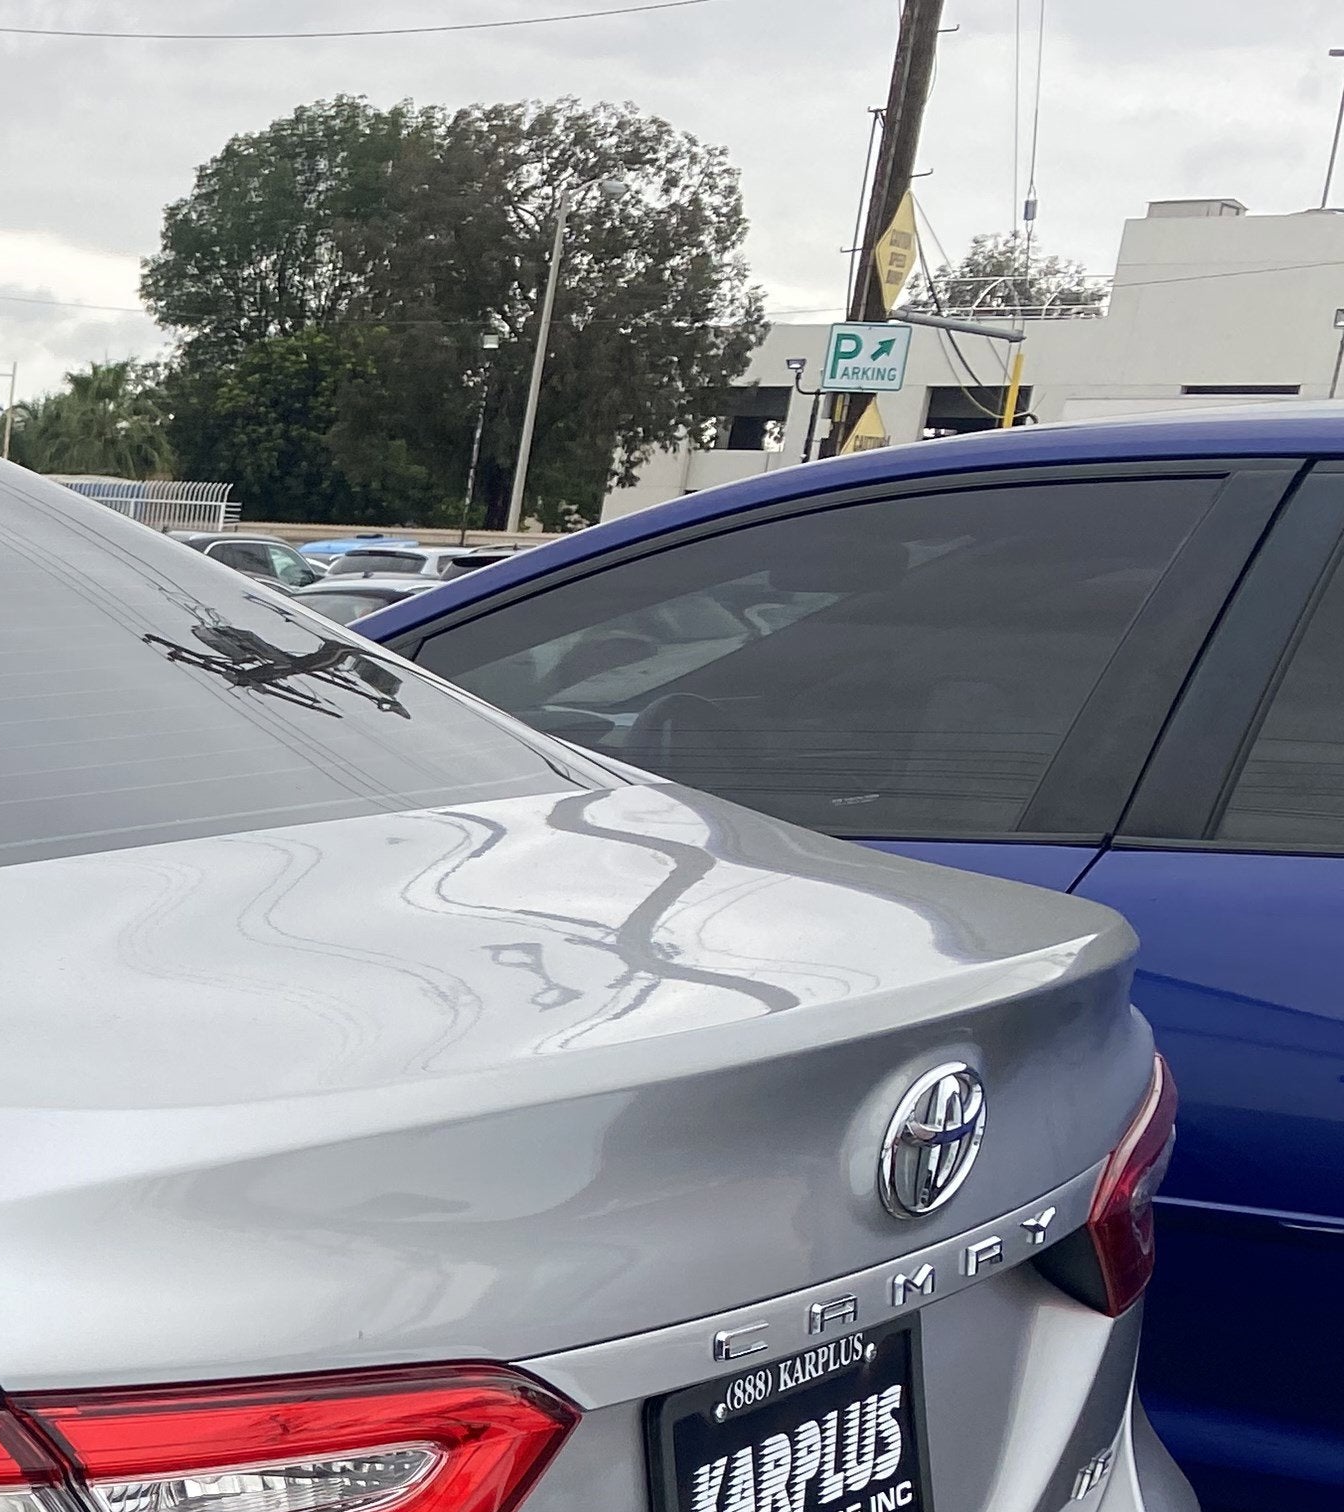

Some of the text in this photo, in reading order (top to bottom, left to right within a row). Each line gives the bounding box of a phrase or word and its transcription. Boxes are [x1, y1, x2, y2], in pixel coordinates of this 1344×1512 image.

[714, 1206, 1056, 1362] CAMRY
[725, 1333, 865, 1412] (888) KARPLUS
